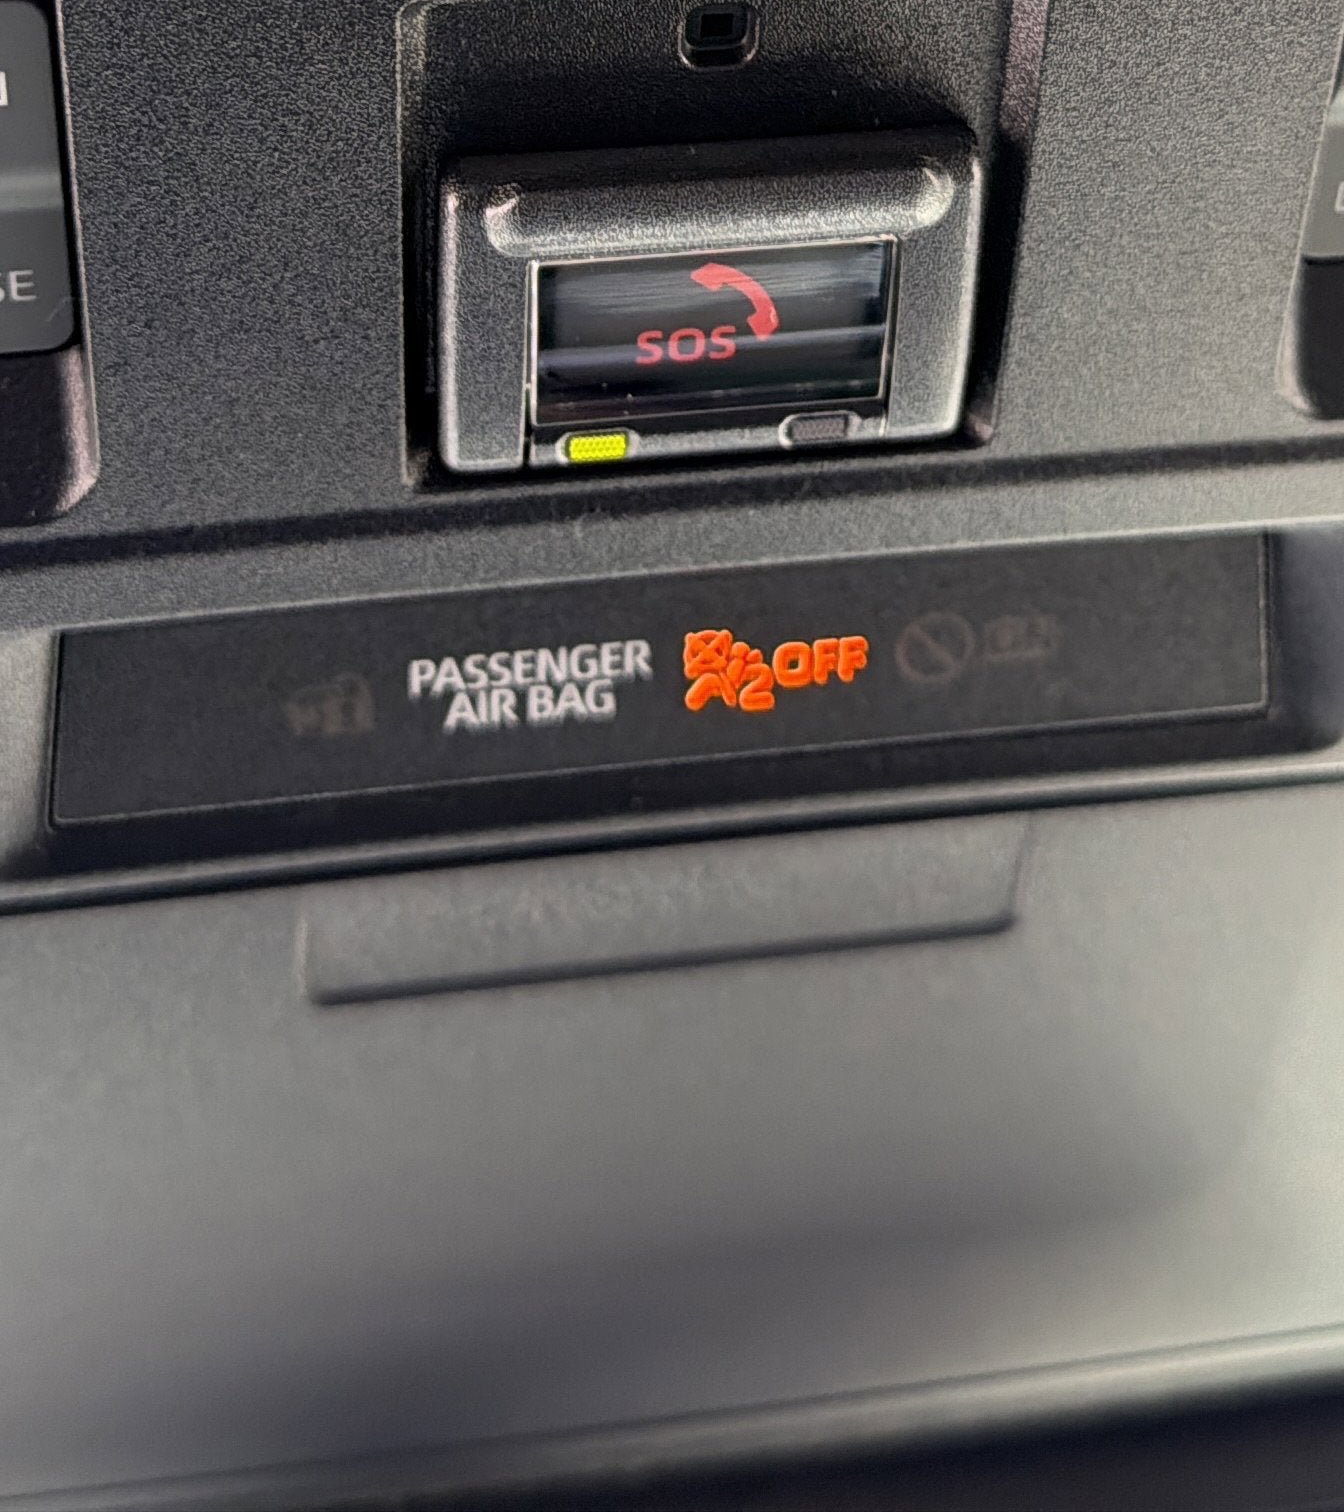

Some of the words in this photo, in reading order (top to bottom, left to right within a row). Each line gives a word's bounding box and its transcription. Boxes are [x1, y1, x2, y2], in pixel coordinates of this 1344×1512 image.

[636, 324, 737, 366] SOS
[408, 639, 652, 698] PASSENGER
[773, 636, 869, 687] OFF
[443, 687, 518, 733] AIR
[526, 680, 616, 722] BAG
